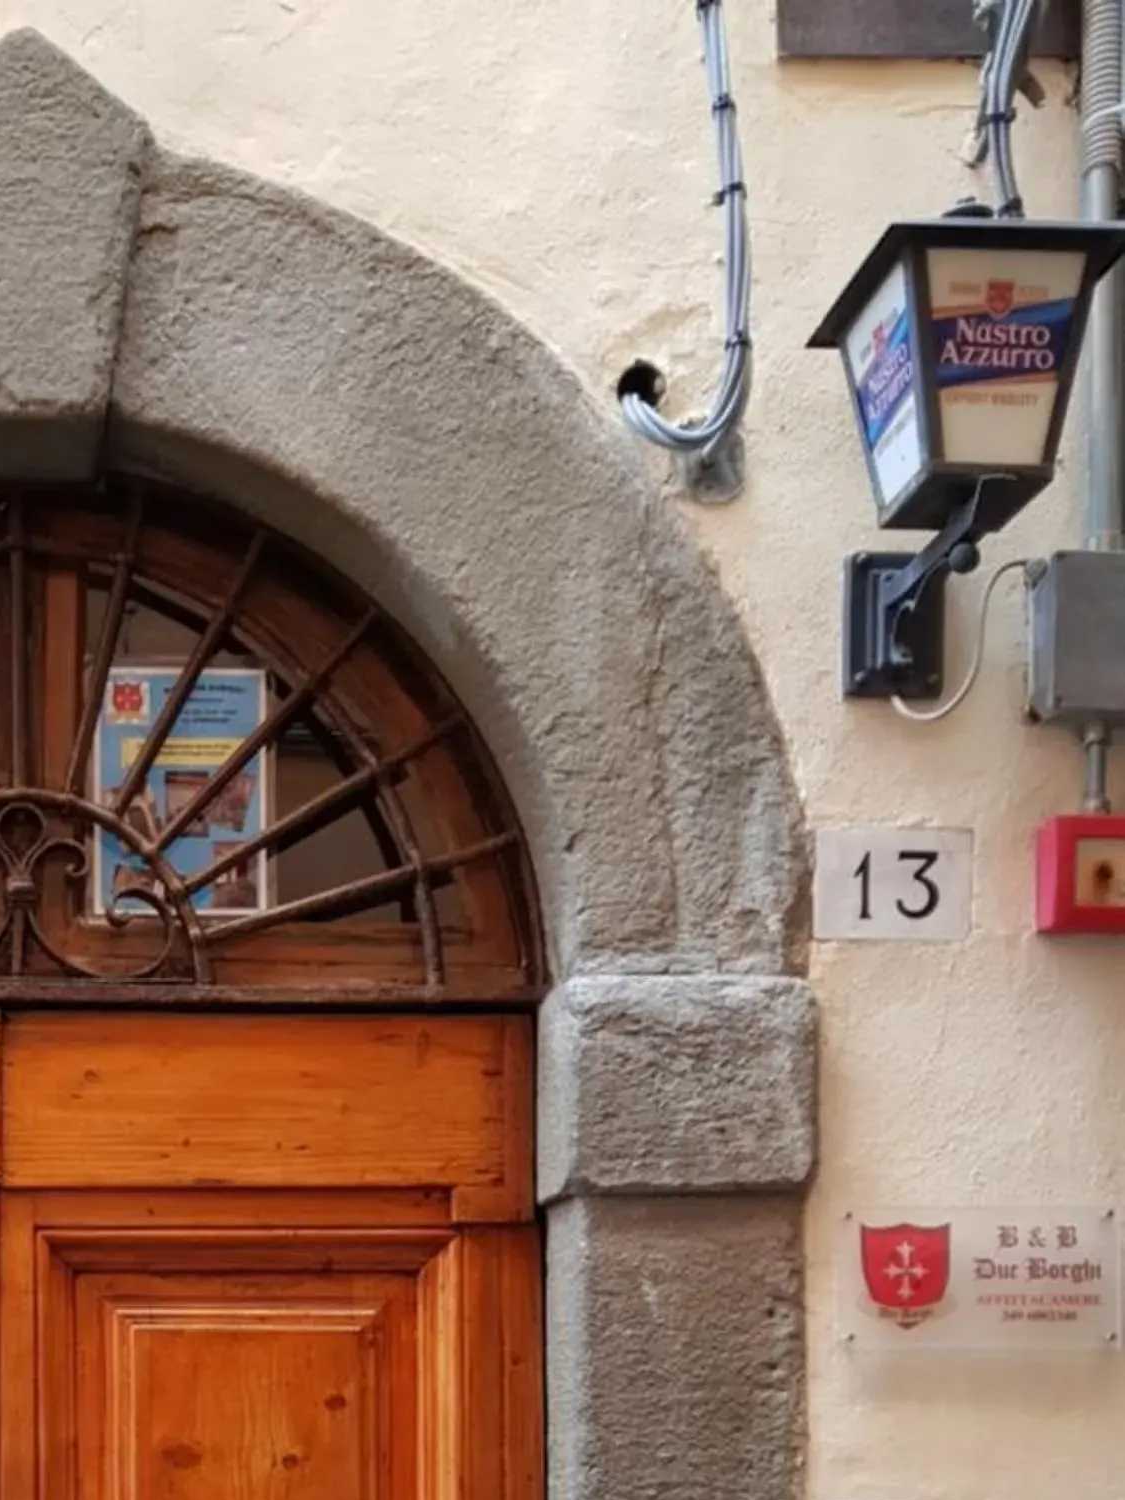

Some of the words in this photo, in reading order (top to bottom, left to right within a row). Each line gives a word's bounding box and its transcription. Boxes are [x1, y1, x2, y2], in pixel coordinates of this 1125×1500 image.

[956, 318, 1051, 346] Nastro
[939, 339, 1055, 370] Azzurro
[853, 850, 940, 921] 13
[996, 1225, 1019, 1249] B
[1027, 1226, 1047, 1249] &
[1024, 1257, 1102, 1285] Borghi
